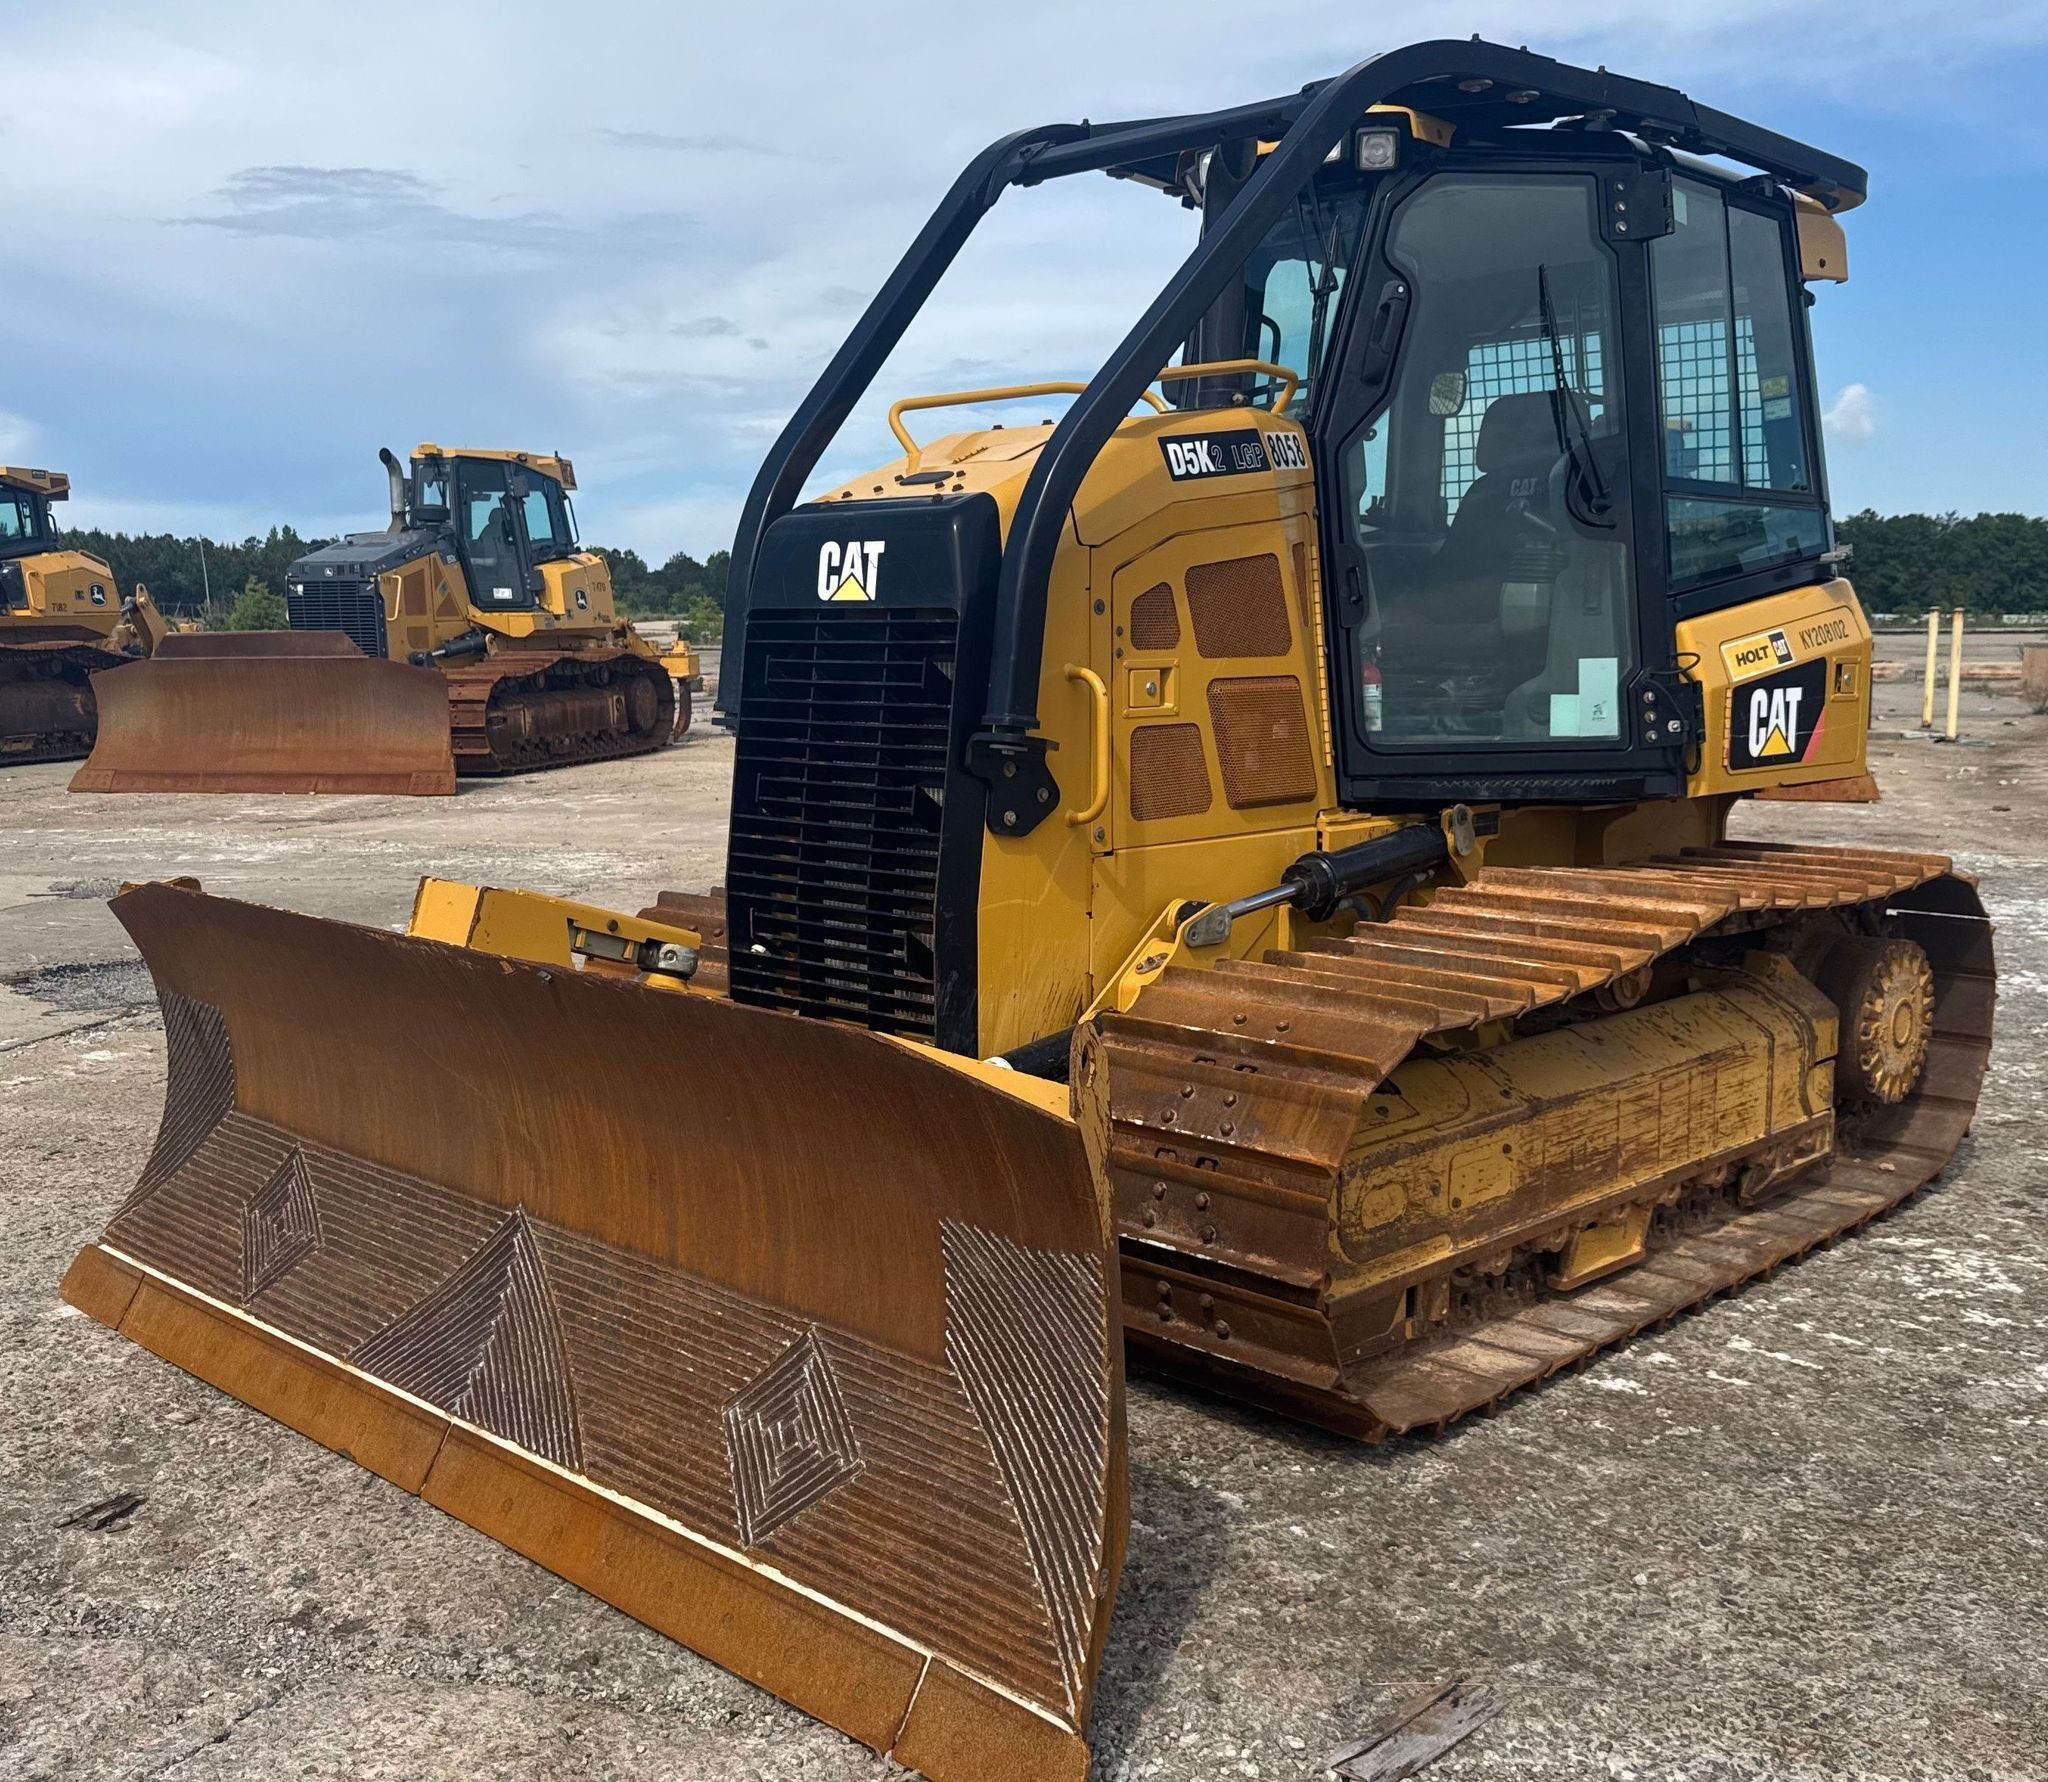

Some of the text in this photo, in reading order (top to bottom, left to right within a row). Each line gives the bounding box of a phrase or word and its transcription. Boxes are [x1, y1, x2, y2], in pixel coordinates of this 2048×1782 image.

[1166, 440, 1264, 476] D5K2 LGP
[1268, 434, 1306, 468] 8058
[1510, 478, 1538, 496] CAT
[817, 540, 886, 602] CAT
[1799, 619, 1849, 649] KY208102
[1736, 639, 1788, 667] HOLT CAT
[1748, 686, 1803, 758] CAT
